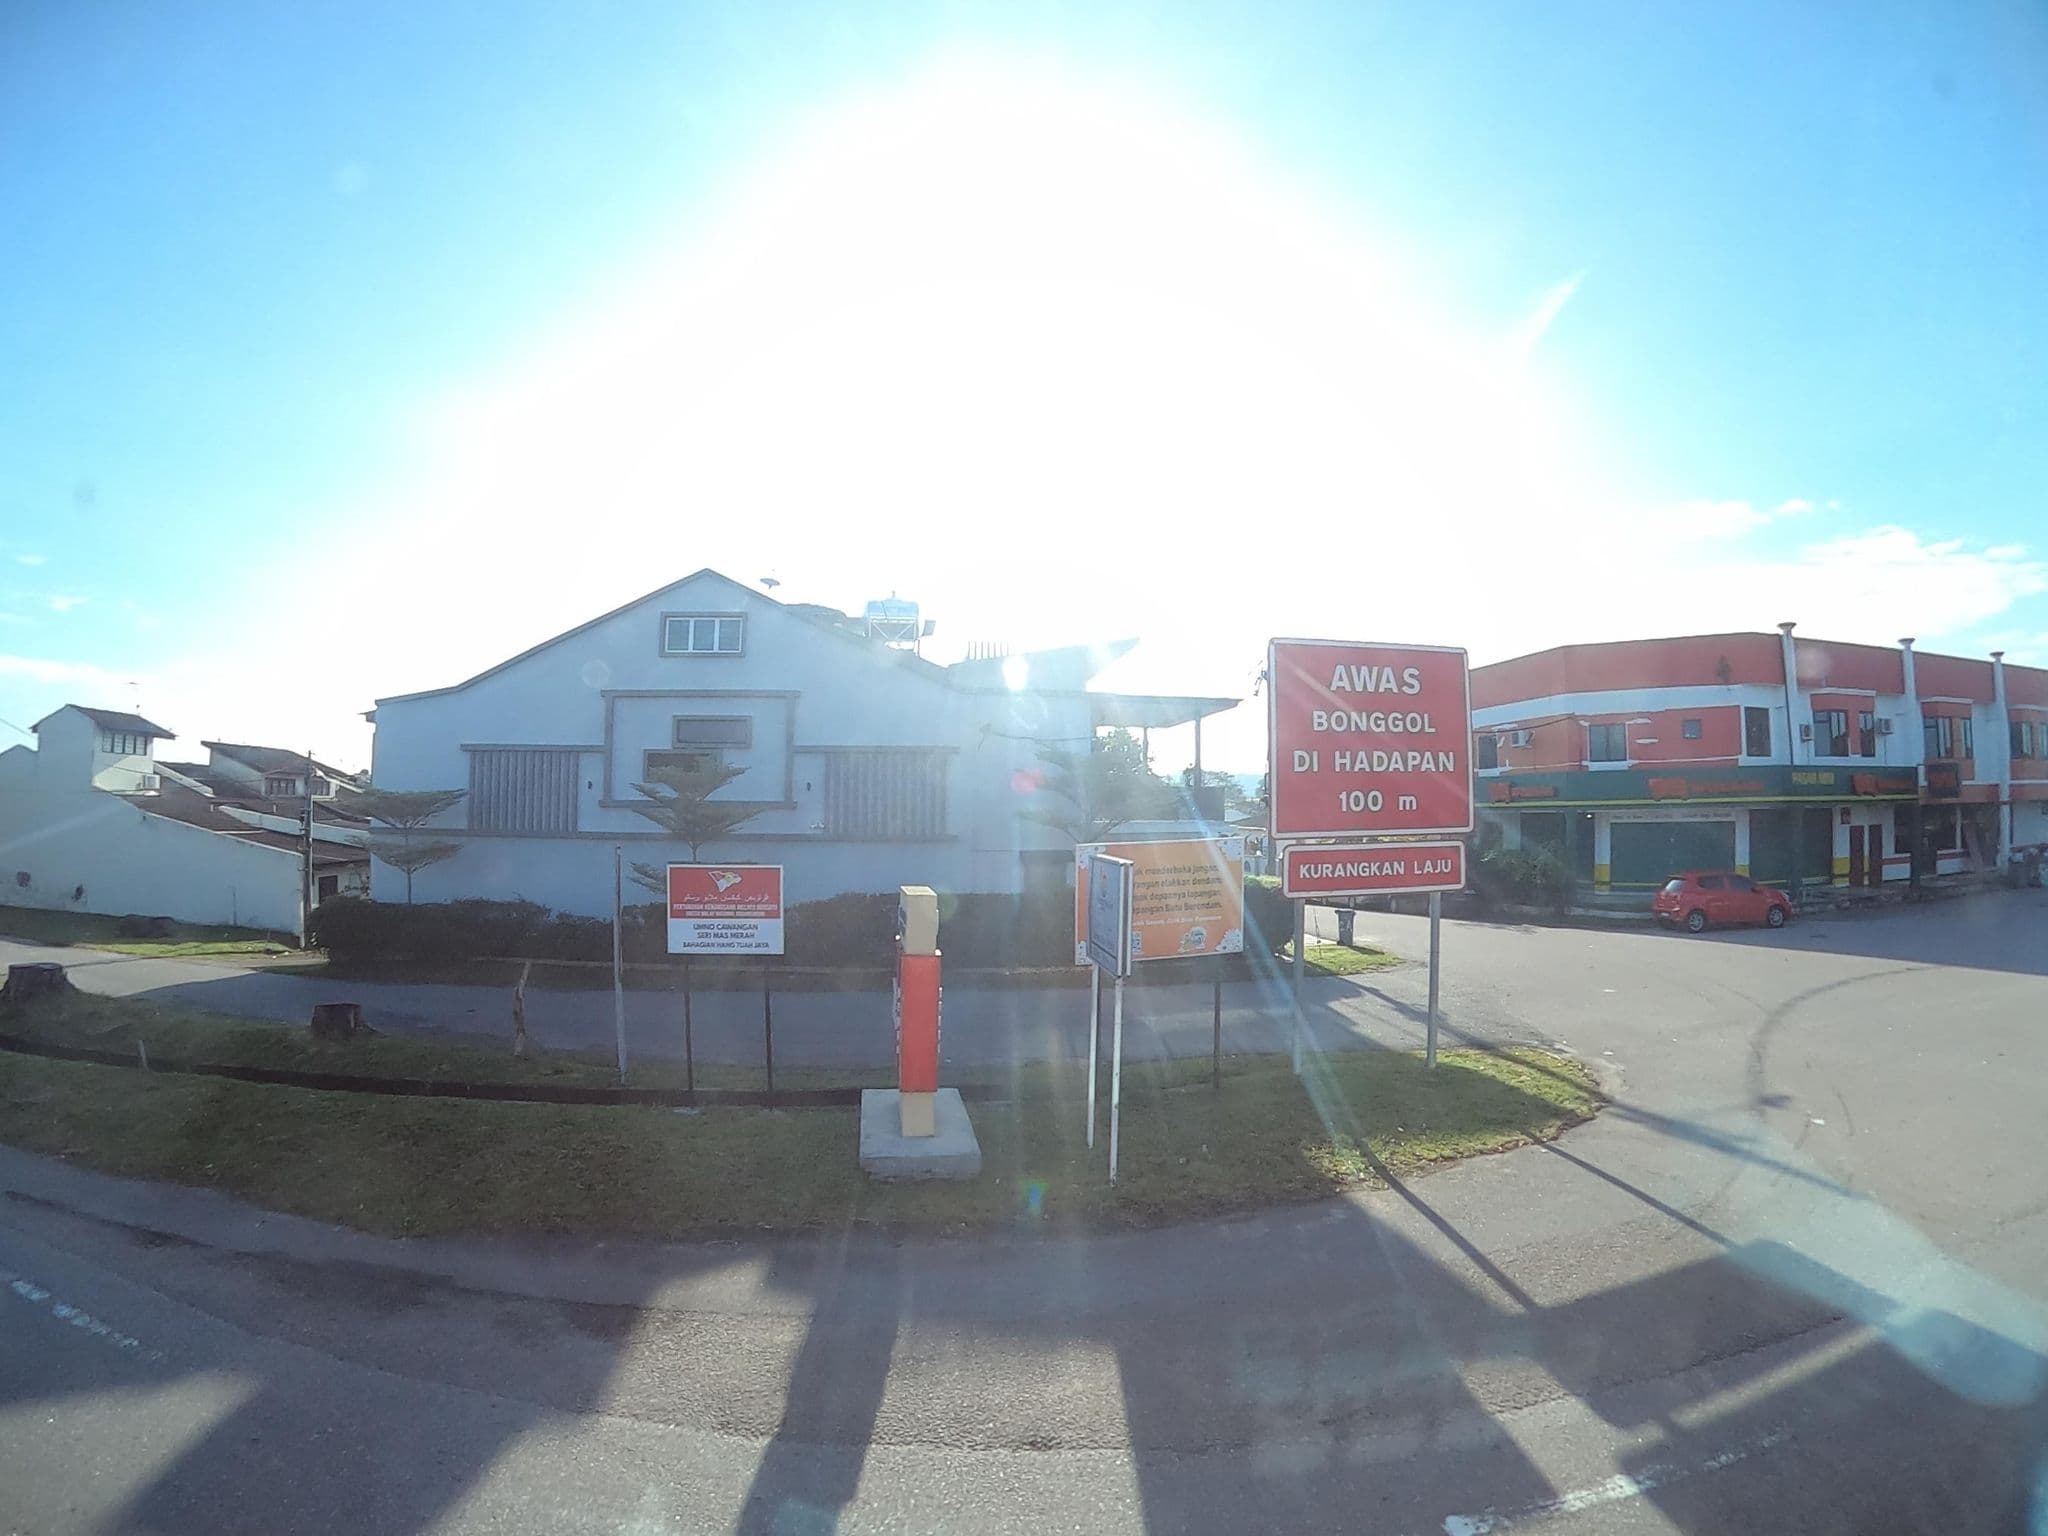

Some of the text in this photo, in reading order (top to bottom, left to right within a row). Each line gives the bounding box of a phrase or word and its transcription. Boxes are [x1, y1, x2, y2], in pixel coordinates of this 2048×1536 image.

[1330, 664, 1422, 695] AWAS
[1312, 710, 1436, 733] BONGGOL
[1293, 750, 1455, 773] DI HADAPAN
[1338, 791, 1418, 812] 100 m
[1299, 858, 1452, 879] KURANGKAN LAJU
